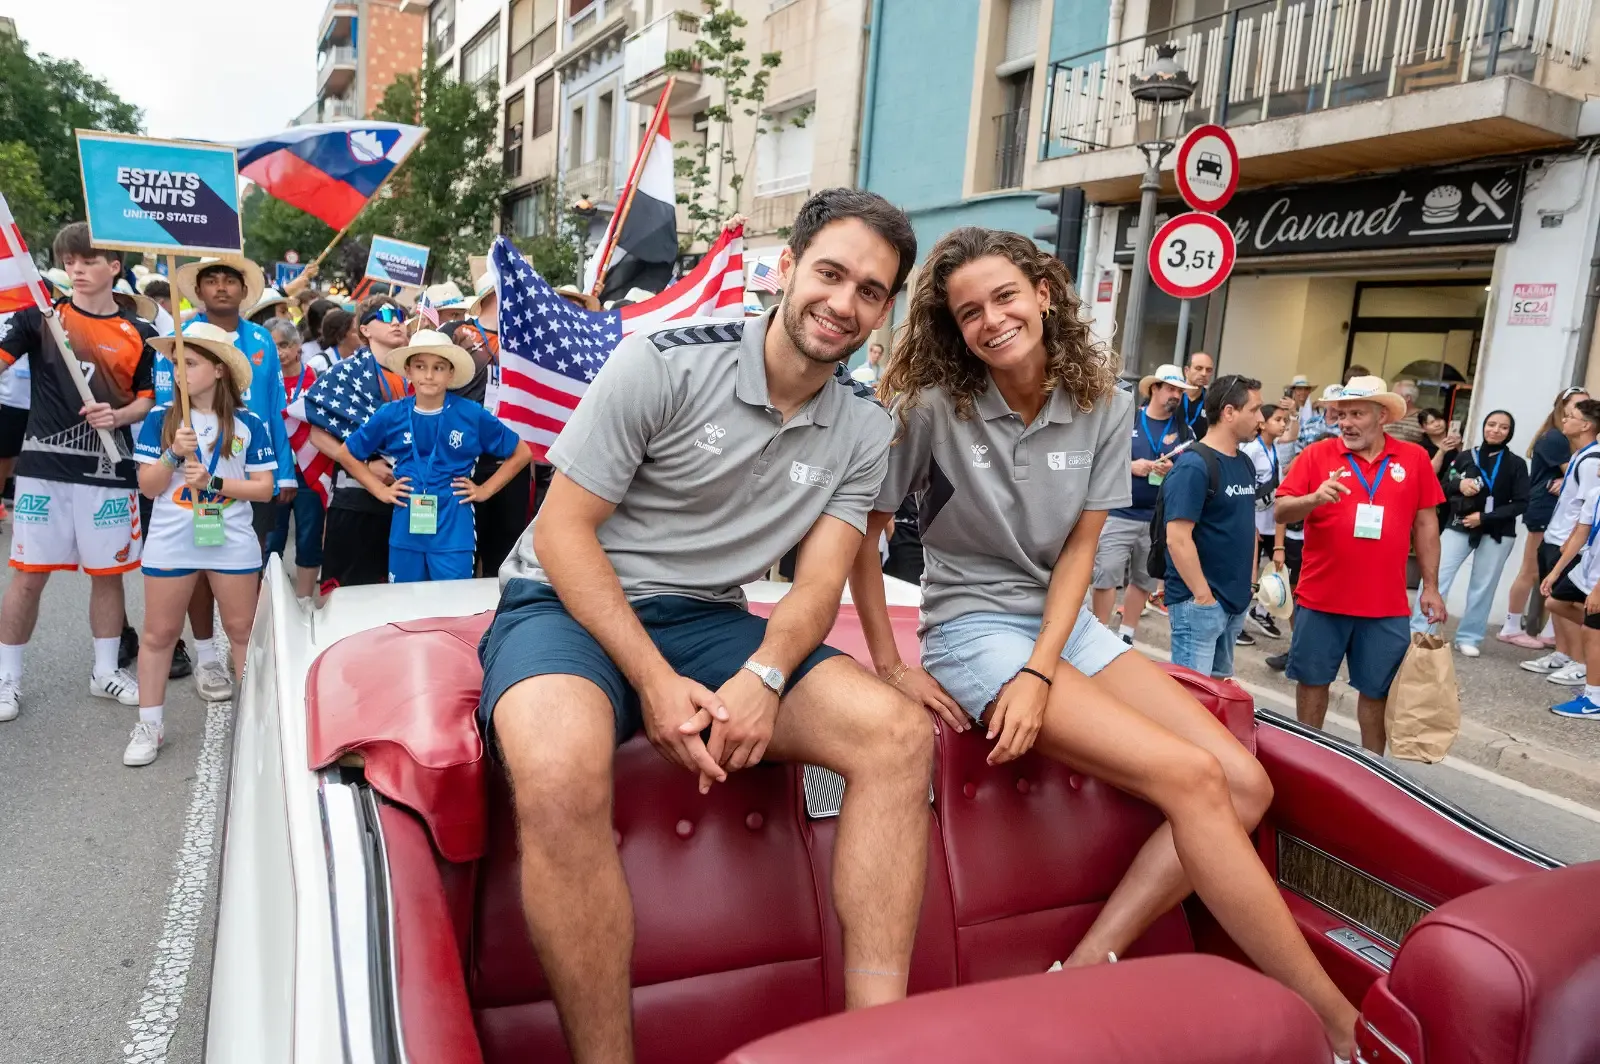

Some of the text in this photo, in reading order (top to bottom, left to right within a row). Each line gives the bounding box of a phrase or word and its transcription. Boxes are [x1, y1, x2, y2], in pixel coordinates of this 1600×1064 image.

[117, 166, 200, 190] ESTATS
[129, 185, 196, 207] UNITS
[123, 209, 208, 224] UNITED STATES
[1254, 190, 1413, 249] Cavanet
[1514, 301, 1548, 313] SC24
[693, 439, 723, 456] hummel
